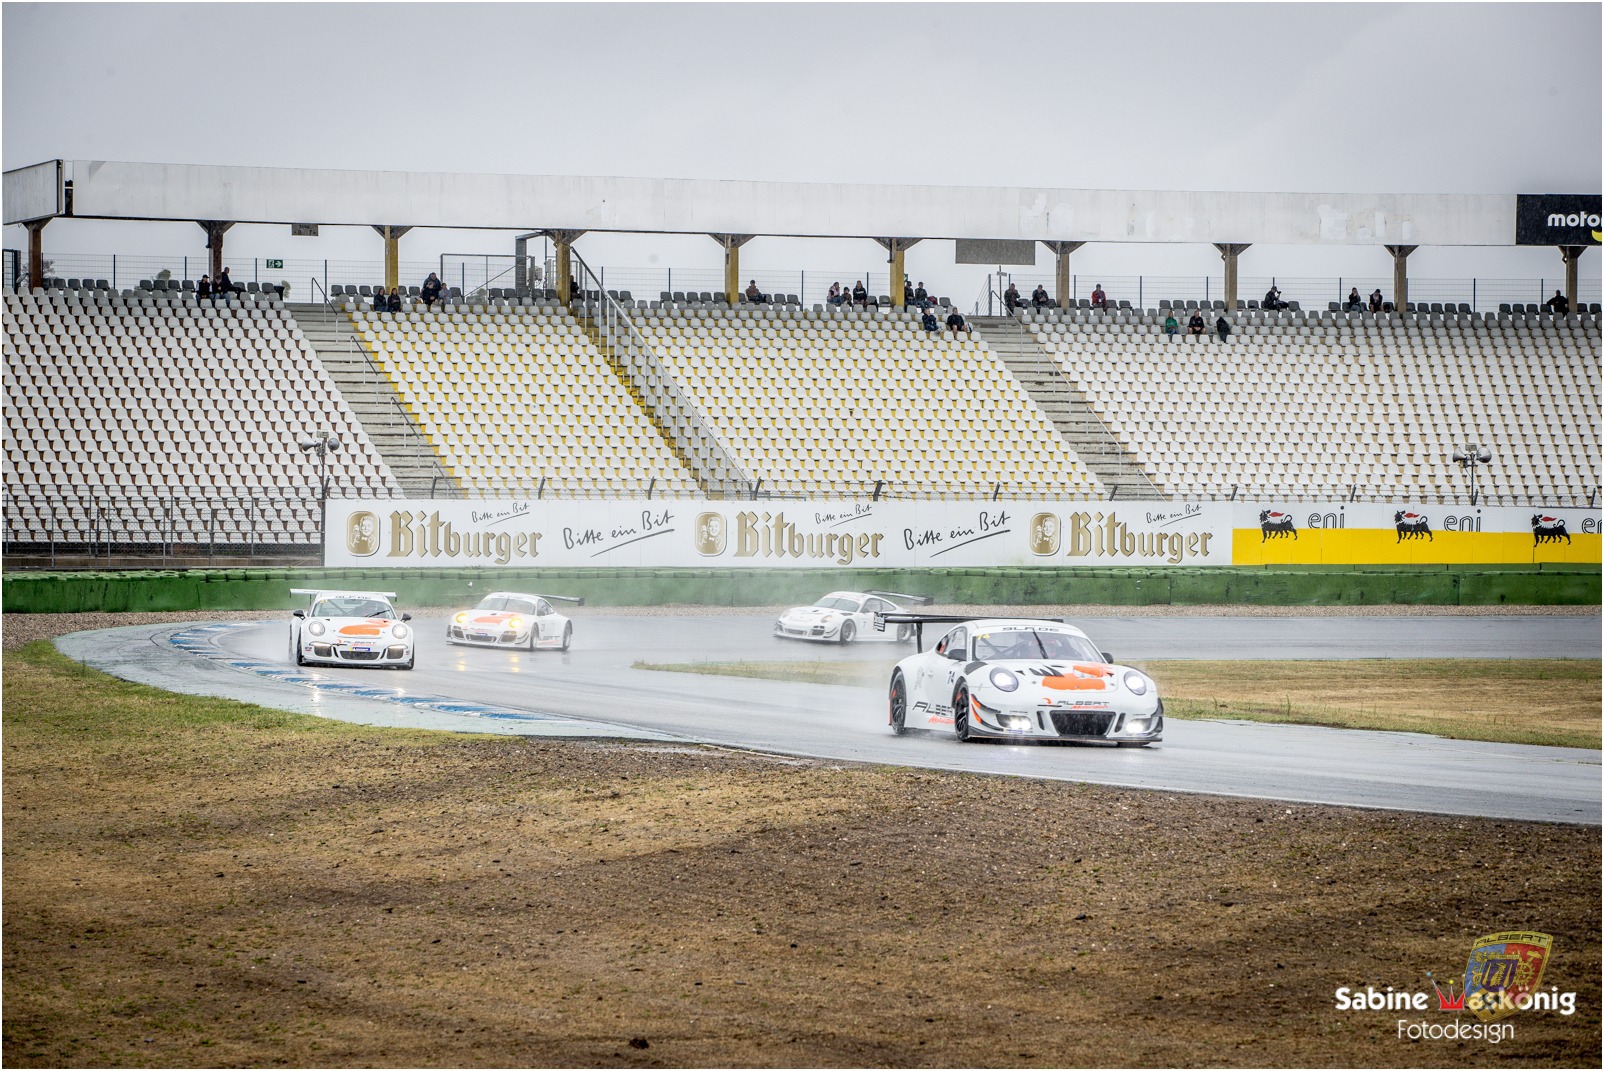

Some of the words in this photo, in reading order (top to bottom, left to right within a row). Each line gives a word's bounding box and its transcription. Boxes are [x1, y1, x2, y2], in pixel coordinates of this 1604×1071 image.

[1547, 211, 1602, 227] moto
[471, 510, 493, 523] Bitte
[497, 510, 510, 518] ein
[512, 502, 530, 514] Bit
[815, 512, 836, 525] Bitte
[840, 511, 853, 519] ein
[855, 503, 872, 515] Bit
[1146, 512, 1166, 524] Bitte
[1185, 503, 1202, 514] Bit
[1307, 505, 1345, 529] eni
[1443, 508, 1481, 532] eni
[386, 510, 543, 565] Bitburger
[563, 527, 604, 550] Bitte
[611, 525, 637, 539] ein
[642, 509, 675, 531] Bit
[733, 511, 885, 566] Bitburger
[903, 528, 943, 551] Bitte
[949, 526, 975, 539] ein
[979, 510, 1011, 531] Bit
[1066, 511, 1213, 565] Bitburger
